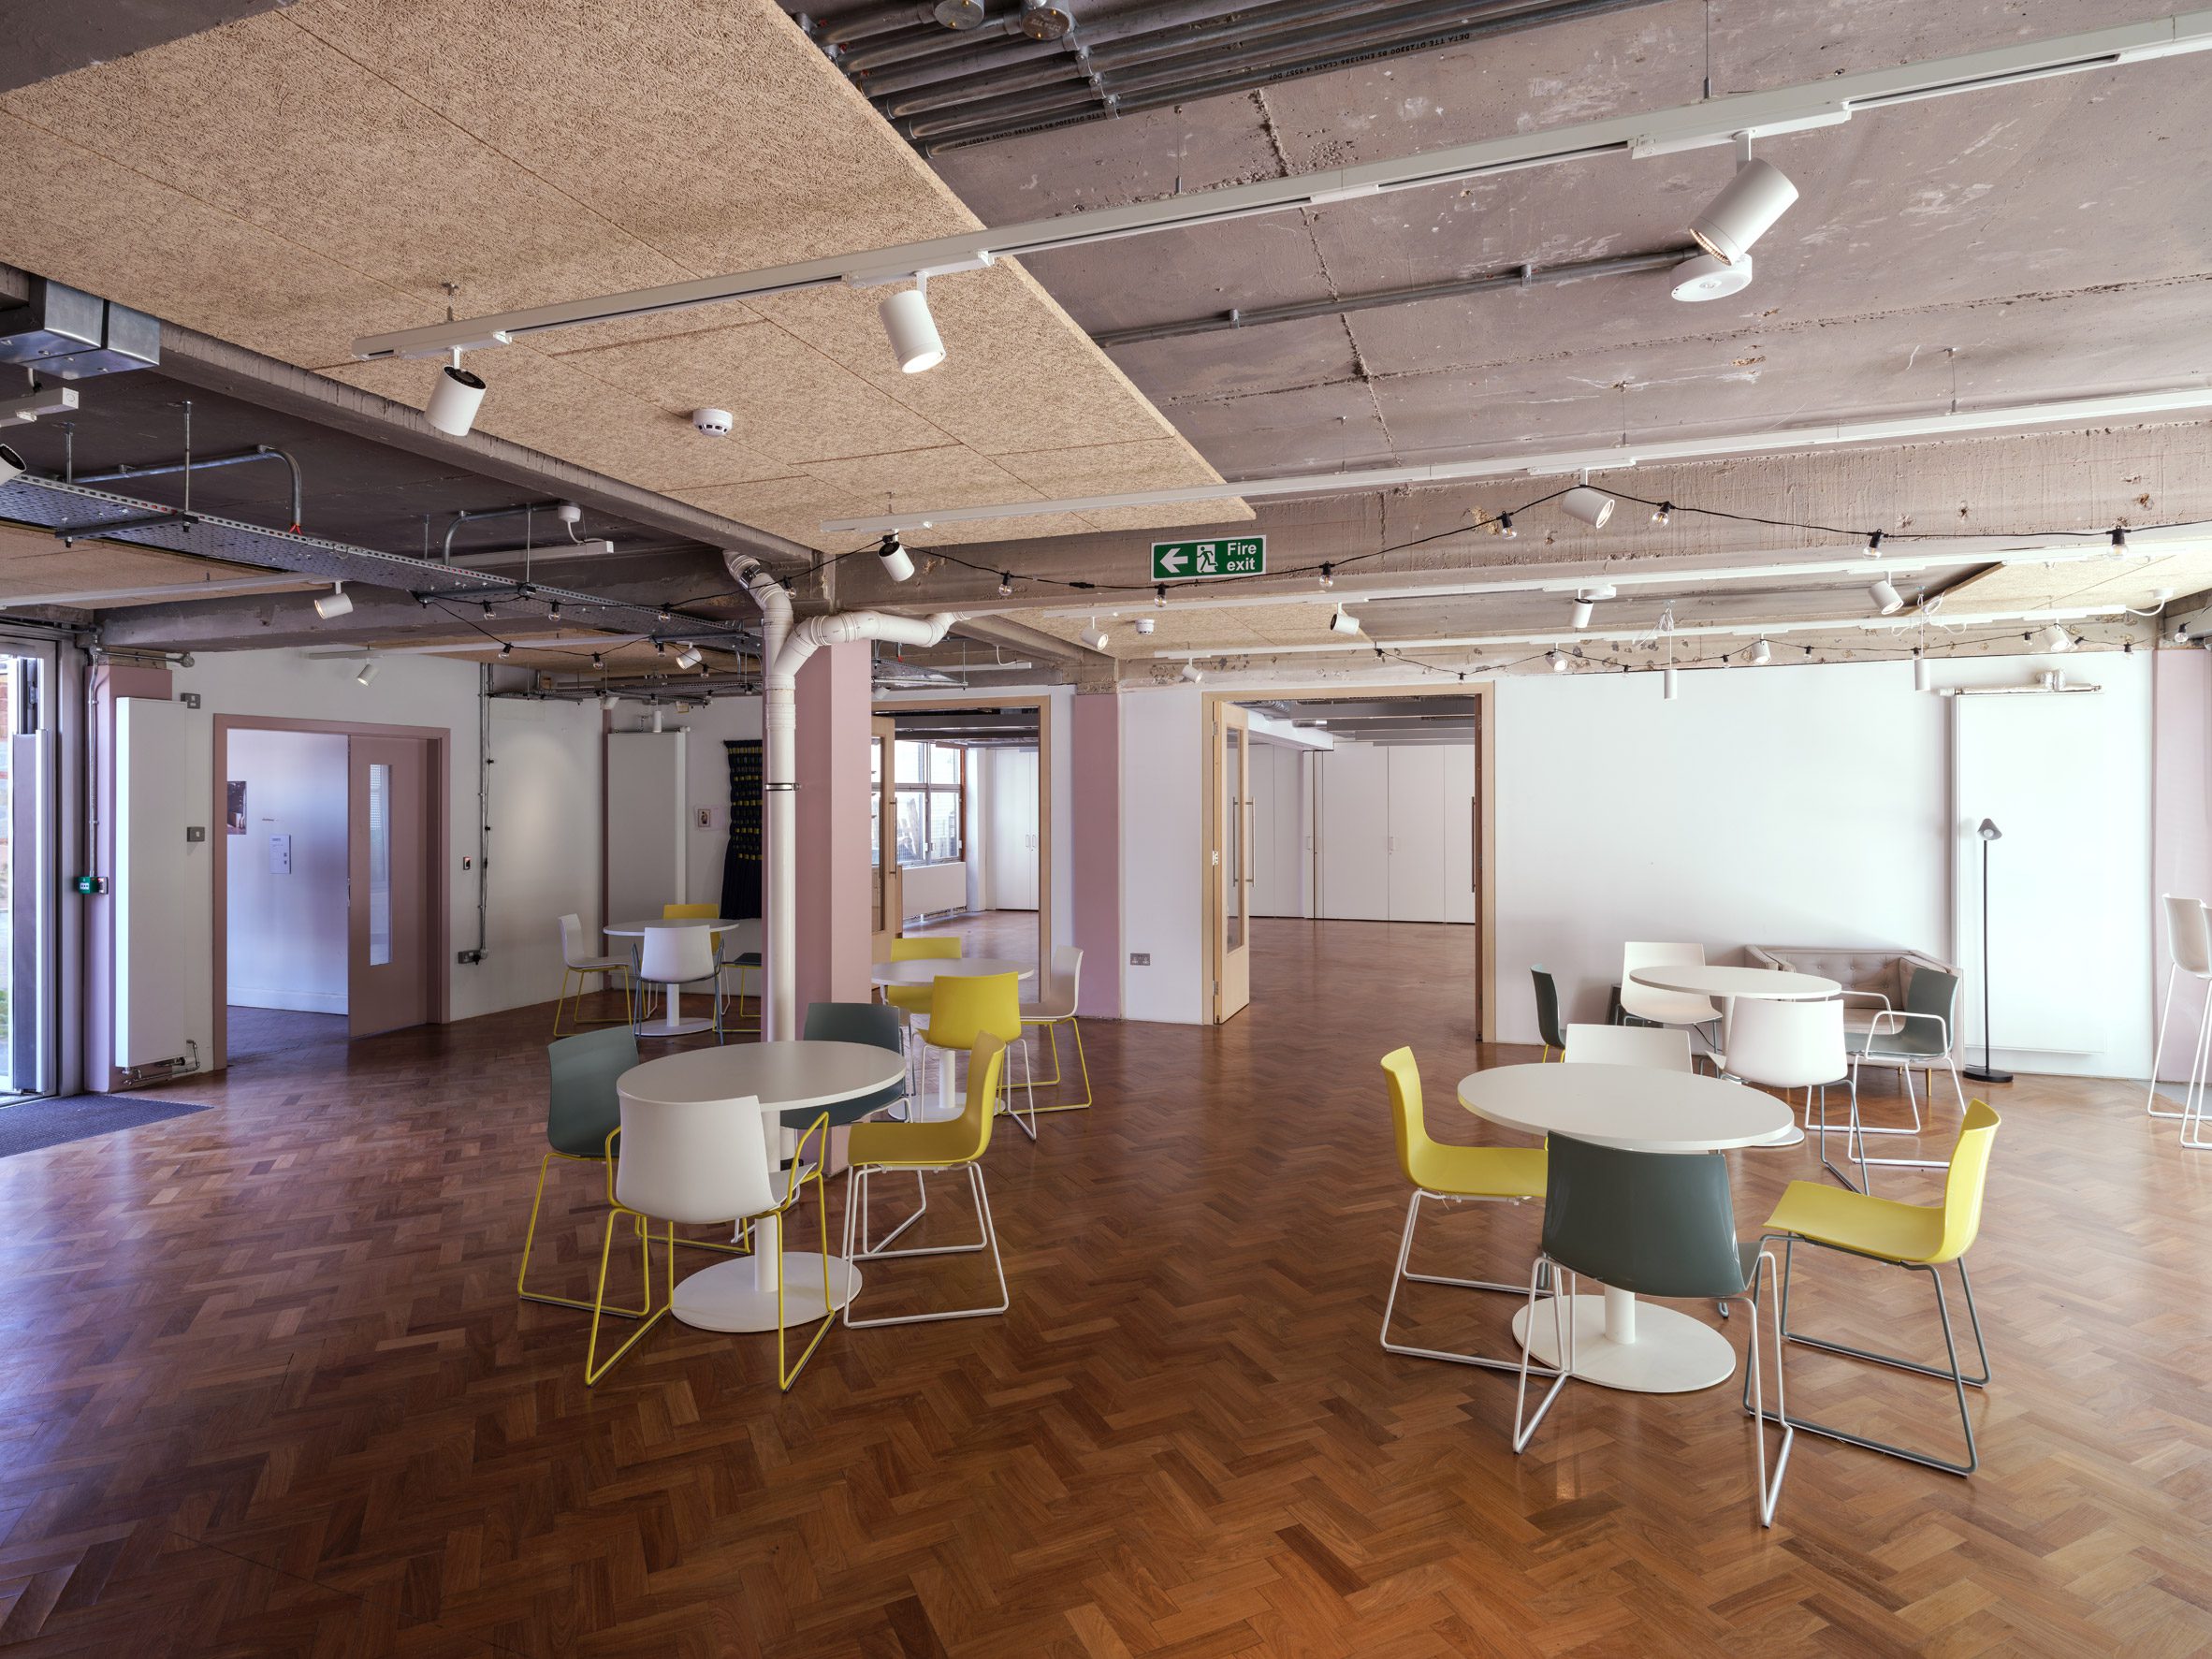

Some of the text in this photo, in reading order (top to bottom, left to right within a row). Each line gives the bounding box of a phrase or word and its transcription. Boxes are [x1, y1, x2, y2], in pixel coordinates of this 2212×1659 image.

[1429, 37, 1446, 47] TTE
[1314, 61, 1338, 70] CLASS
[992, 131, 1011, 139] CLASS
[1227, 542, 1257, 556] Fire
[1227, 557, 1256, 572] exit
